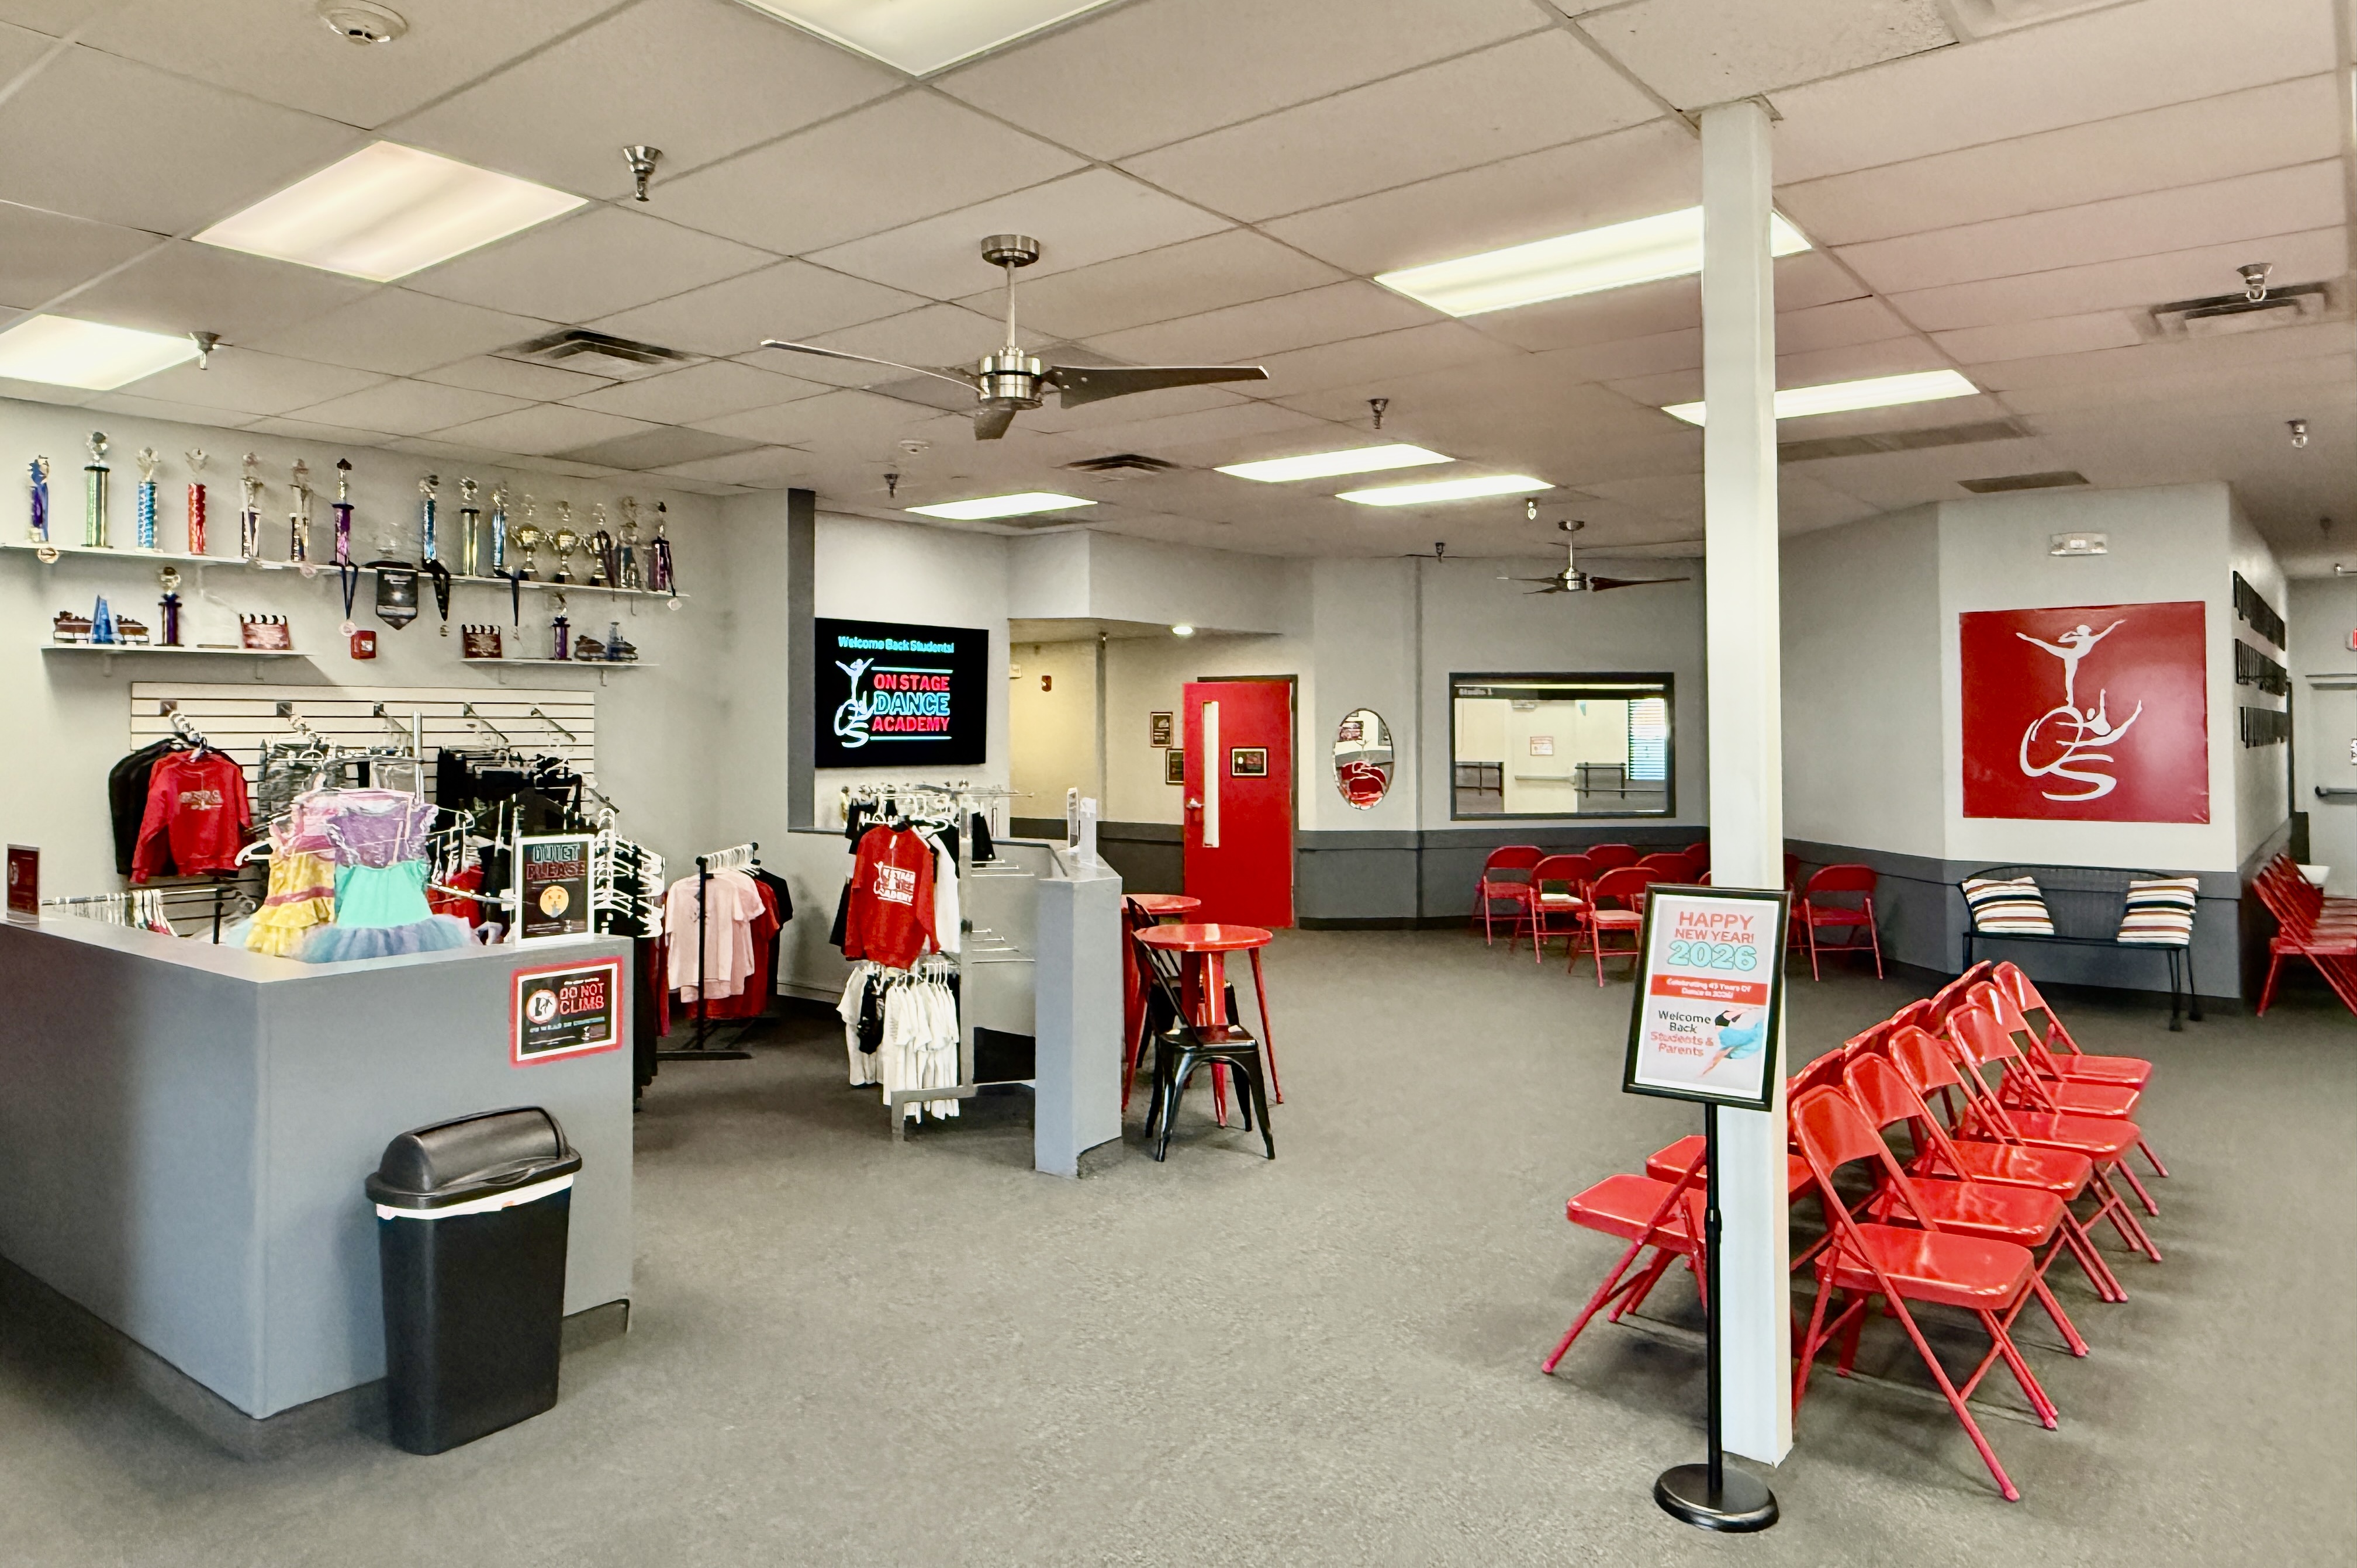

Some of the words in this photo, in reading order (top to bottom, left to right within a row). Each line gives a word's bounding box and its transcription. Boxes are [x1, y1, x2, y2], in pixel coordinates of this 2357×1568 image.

[838, 636, 884, 649] Welcome
[885, 639, 910, 650] Back
[873, 673, 897, 690] ON
[899, 674, 950, 691] STAGE
[873, 691, 951, 716] DANCE
[872, 716, 950, 732] ACADEMY
[526, 860, 586, 880] PLEASE
[1679, 911, 1754, 930] HAPPY
[1674, 928, 1708, 940] NEW
[1711, 930, 1754, 943] YEAR!
[1667, 939, 1757, 971] 2026
[559, 987, 578, 1001] DO
[580, 982, 605, 998] NOT
[559, 995, 604, 1015] CLIMB
[1658, 1010, 1712, 1024] Welcome
[1669, 1022, 1698, 1034] Back
[1650, 1031, 1703, 1046] Students
[1658, 1043, 1704, 1057] Parents
